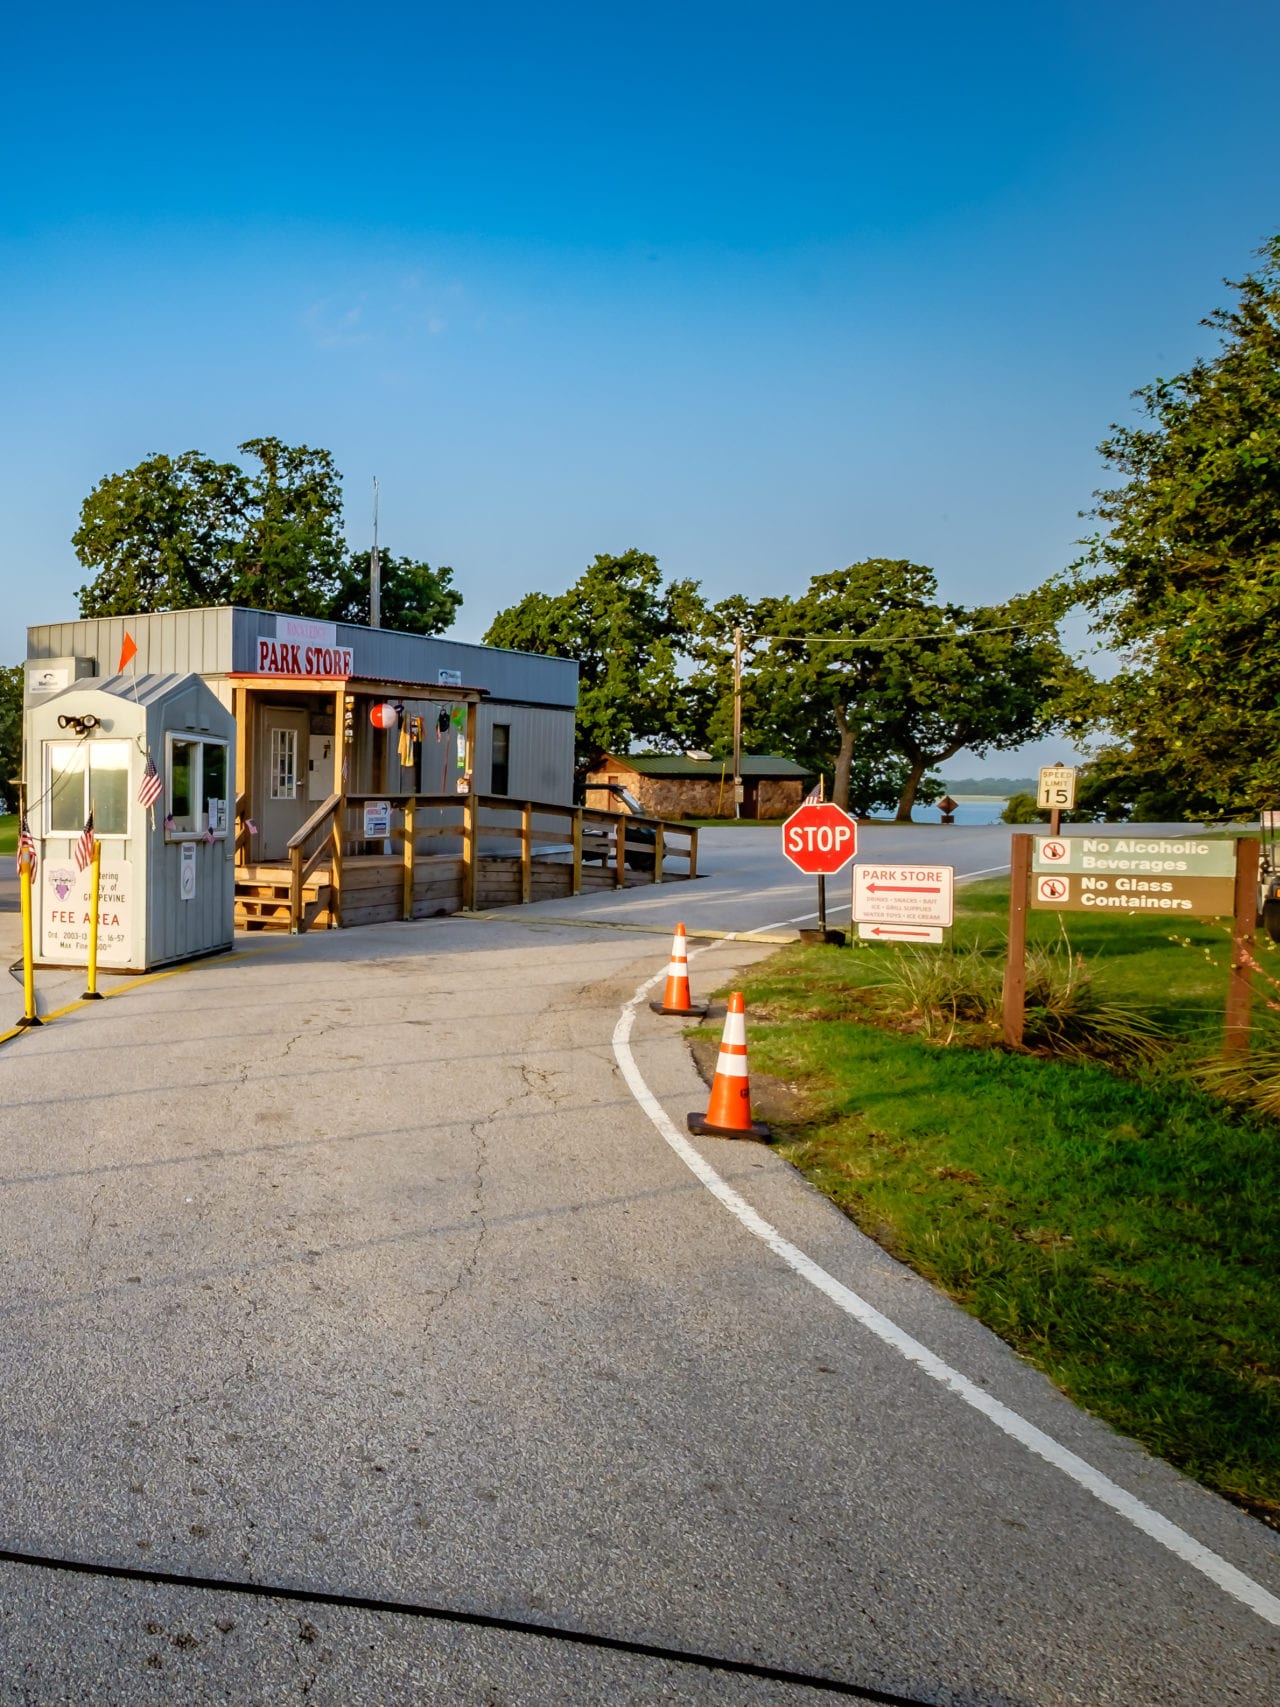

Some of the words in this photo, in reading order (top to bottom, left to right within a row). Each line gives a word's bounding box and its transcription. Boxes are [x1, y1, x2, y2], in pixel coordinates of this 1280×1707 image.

[259, 641, 302, 674] PARK
[305, 646, 352, 675] STORE
[1044, 789, 1068, 804] 15
[789, 826, 851, 852] STOP
[1083, 840, 1110, 853] No
[1115, 840, 1209, 855] Alcoholic
[1082, 856, 1188, 873] Beverages
[863, 870, 897, 881] PARK
[901, 871, 943, 882] STORE
[1081, 877, 1108, 890] No
[1115, 878, 1174, 892] Glass
[83, 893, 126, 903] GPEVINE
[1081, 893, 1193, 909] Containers
[51, 911, 75, 924] FEE
[83, 912, 120, 926] AREA
